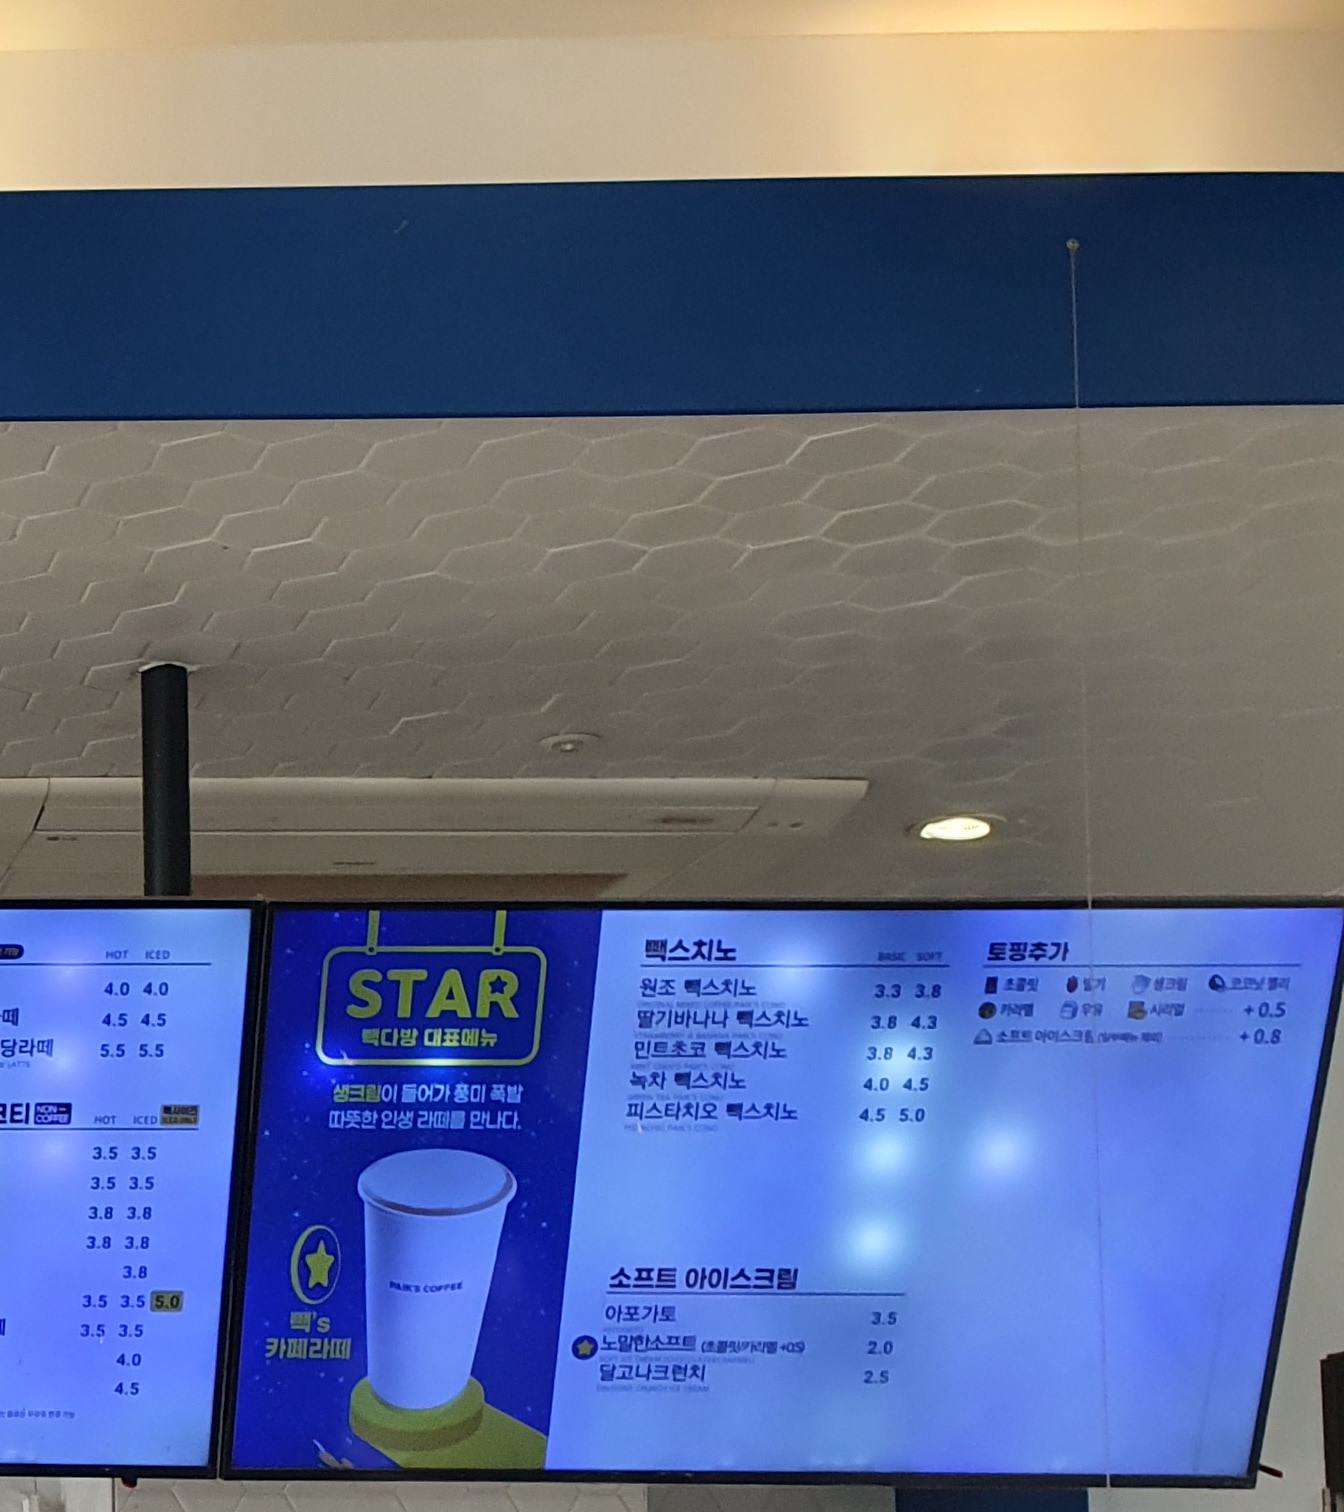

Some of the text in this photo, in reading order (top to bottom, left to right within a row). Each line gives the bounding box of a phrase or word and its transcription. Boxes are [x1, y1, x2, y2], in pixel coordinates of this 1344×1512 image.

[987, 942, 1069, 961] 토핑추가
[346, 969, 520, 1019] STAR
[640, 978, 676, 997] 원조
[637, 1009, 728, 1029] 딸기바나나
[609, 1268, 798, 1290] 소프트 아이스크림
[605, 1305, 676, 1323] 아포가토
[871, 1311, 897, 1325] 3.5
[867, 1341, 893, 1354] 2.0
[599, 1364, 706, 1382] 달고나크런치
[864, 1370, 889, 1384] 2.5
